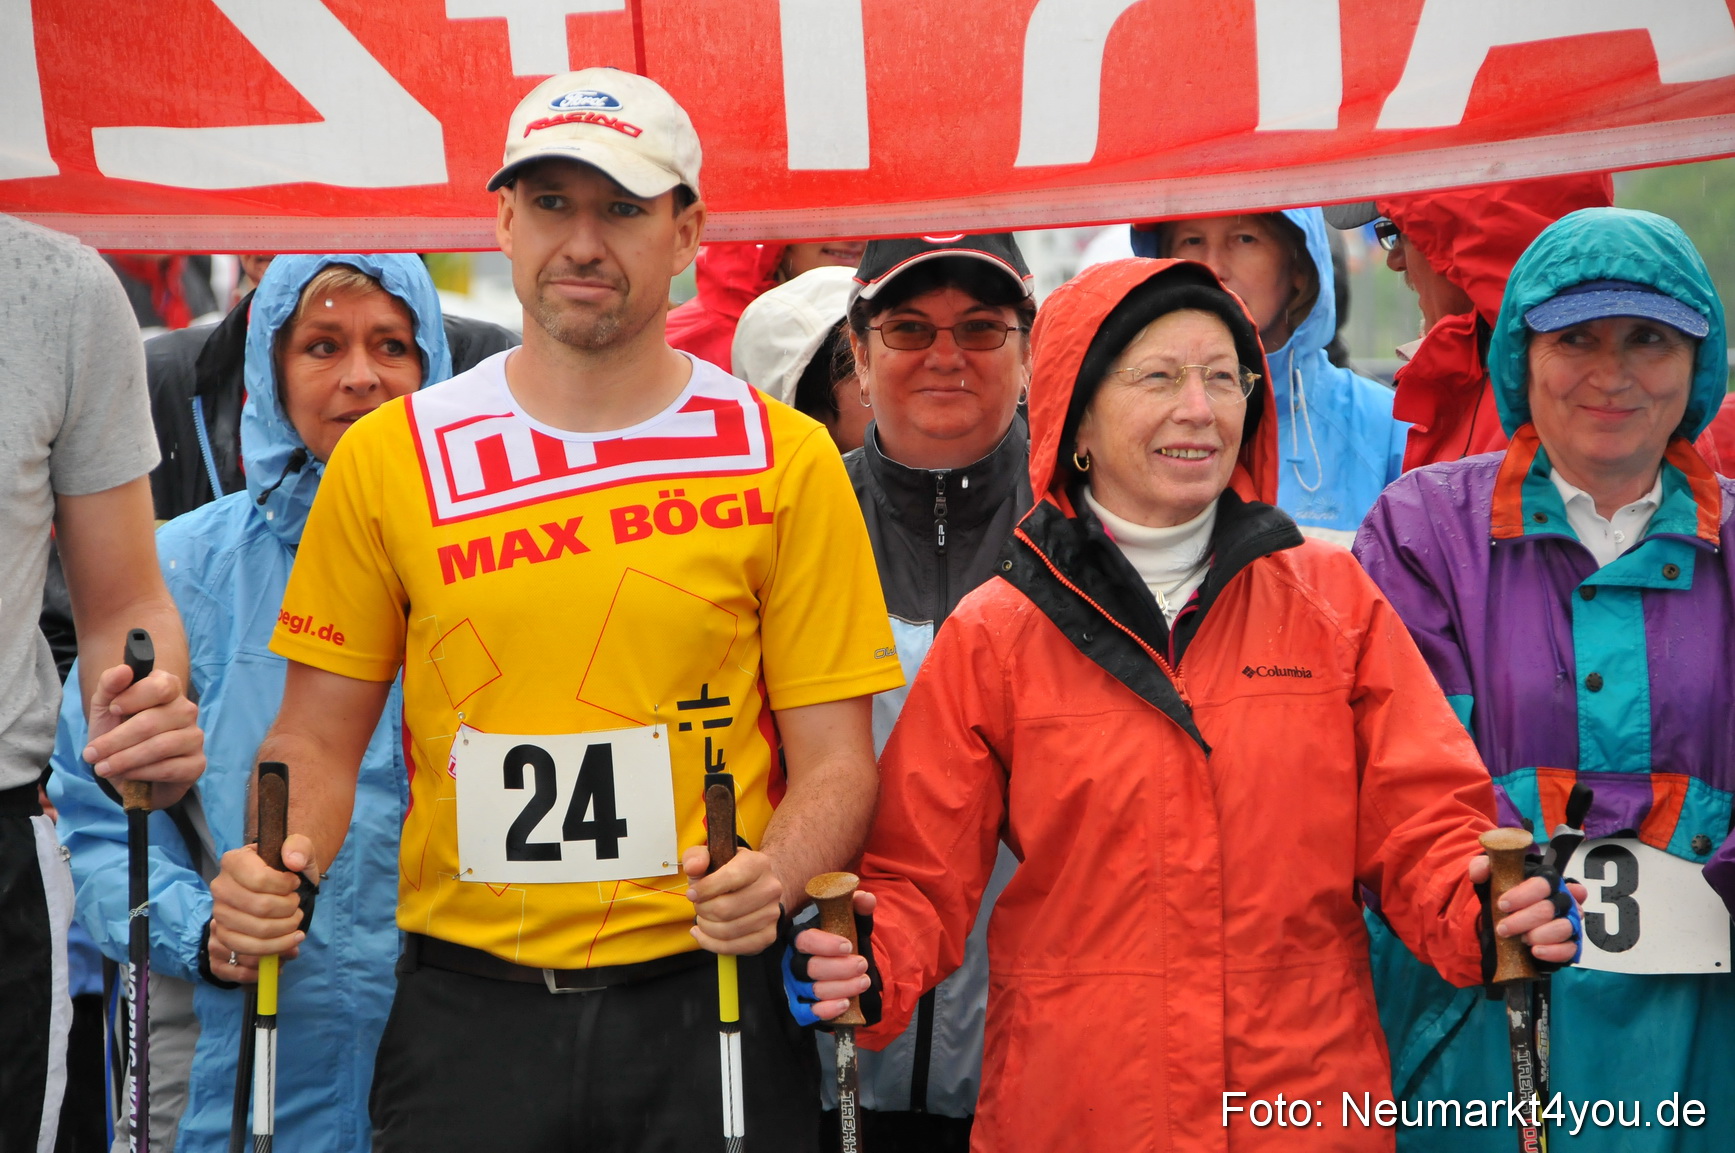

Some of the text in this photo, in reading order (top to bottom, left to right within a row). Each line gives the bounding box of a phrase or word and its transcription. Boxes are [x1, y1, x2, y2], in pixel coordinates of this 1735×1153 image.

[523, 111, 643, 138] RACING
[560, 91, 608, 107] Ford
[437, 488, 773, 585] MAX BÖGL
[1256, 665, 1312, 678] Columbia
[503, 743, 628, 861] 24
[1584, 844, 1641, 953] 3
